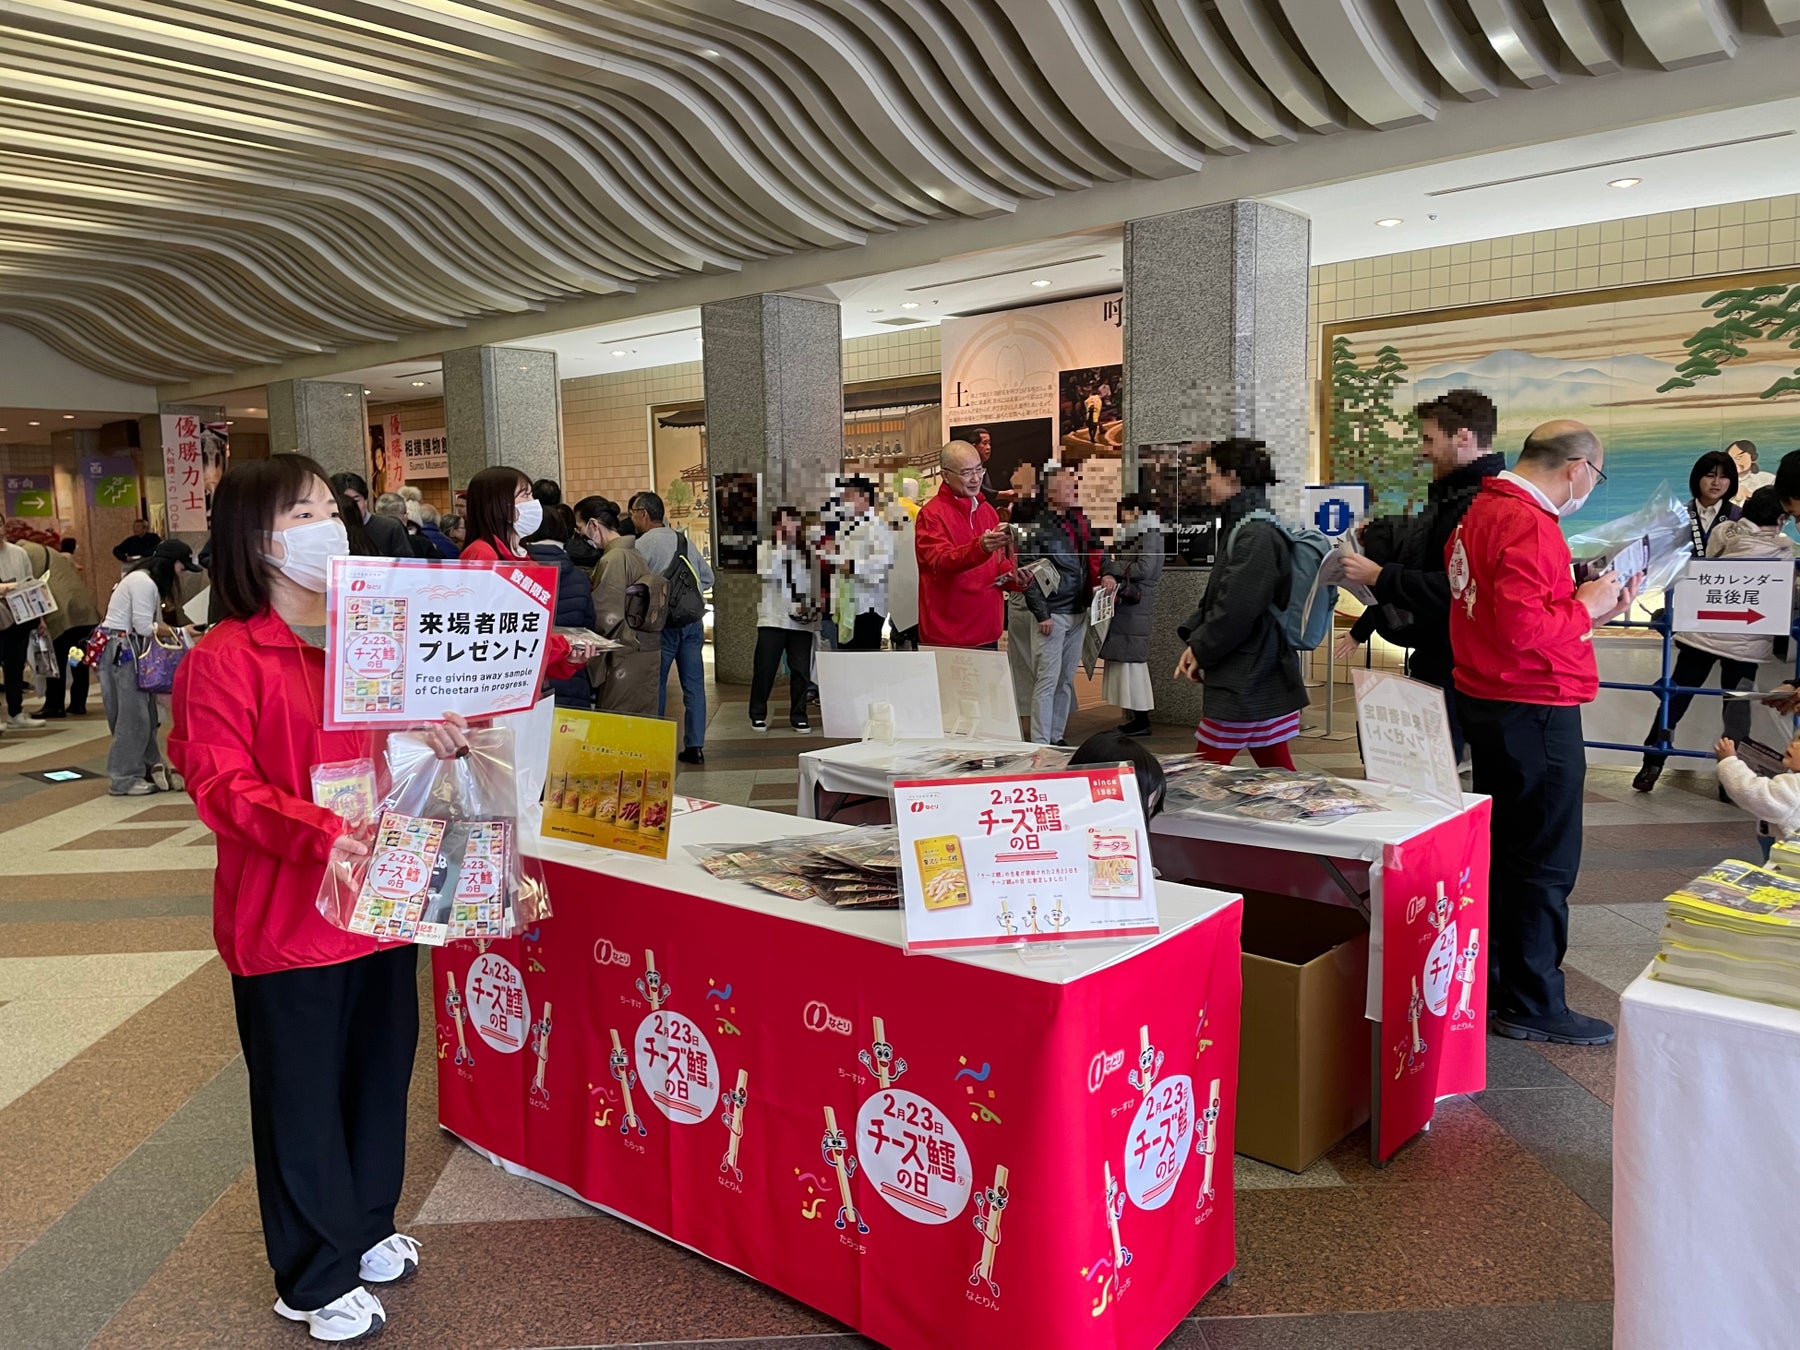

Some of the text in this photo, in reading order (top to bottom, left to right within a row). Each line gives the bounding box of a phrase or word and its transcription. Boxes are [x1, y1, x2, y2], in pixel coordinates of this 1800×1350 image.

[405, 436, 448, 457] 相撲博物館
[175, 416, 204, 511] 優勝力士
[409, 461, 425, 471] Sumo
[509, 568, 552, 604] 数量限定
[1686, 573, 1784, 586] 一枚カレンダー
[1705, 589, 1760, 605] 最後尾
[418, 612, 540, 635] 来場者限定
[367, 660, 383, 668] の日
[415, 668, 533, 684] Free giving away sample
[415, 680, 529, 695] of Cheetara in progress.
[1093, 777, 1118, 787] since
[1095, 786, 1118, 796] 1982
[990, 787, 1048, 806] 2月23日
[1009, 834, 1041, 851] の日
[1092, 841, 1130, 851] チータラ
[377, 863, 422, 883] チーズ鱈
[387, 874, 404, 889] の日
[459, 871, 493, 884] ーズ鱈
[466, 885, 481, 893] の日
[611, 951, 630, 966] なとり
[481, 957, 517, 984] 2月23日
[472, 977, 523, 1020] チーズ鱈
[489, 1013, 508, 1032] の日
[654, 1014, 699, 1047] 2月23日
[827, 1015, 851, 1033] なとり
[838, 1067, 867, 1085] ちーすけ
[665, 1078, 689, 1100] の日
[883, 1093, 944, 1135] 2月23日
[1155, 1152, 1177, 1180] の日
[717, 1175, 743, 1194] なとりん
[896, 1168, 929, 1197] の日
[838, 1233, 867, 1255] たらっち
[965, 1288, 1000, 1311] なとりん
